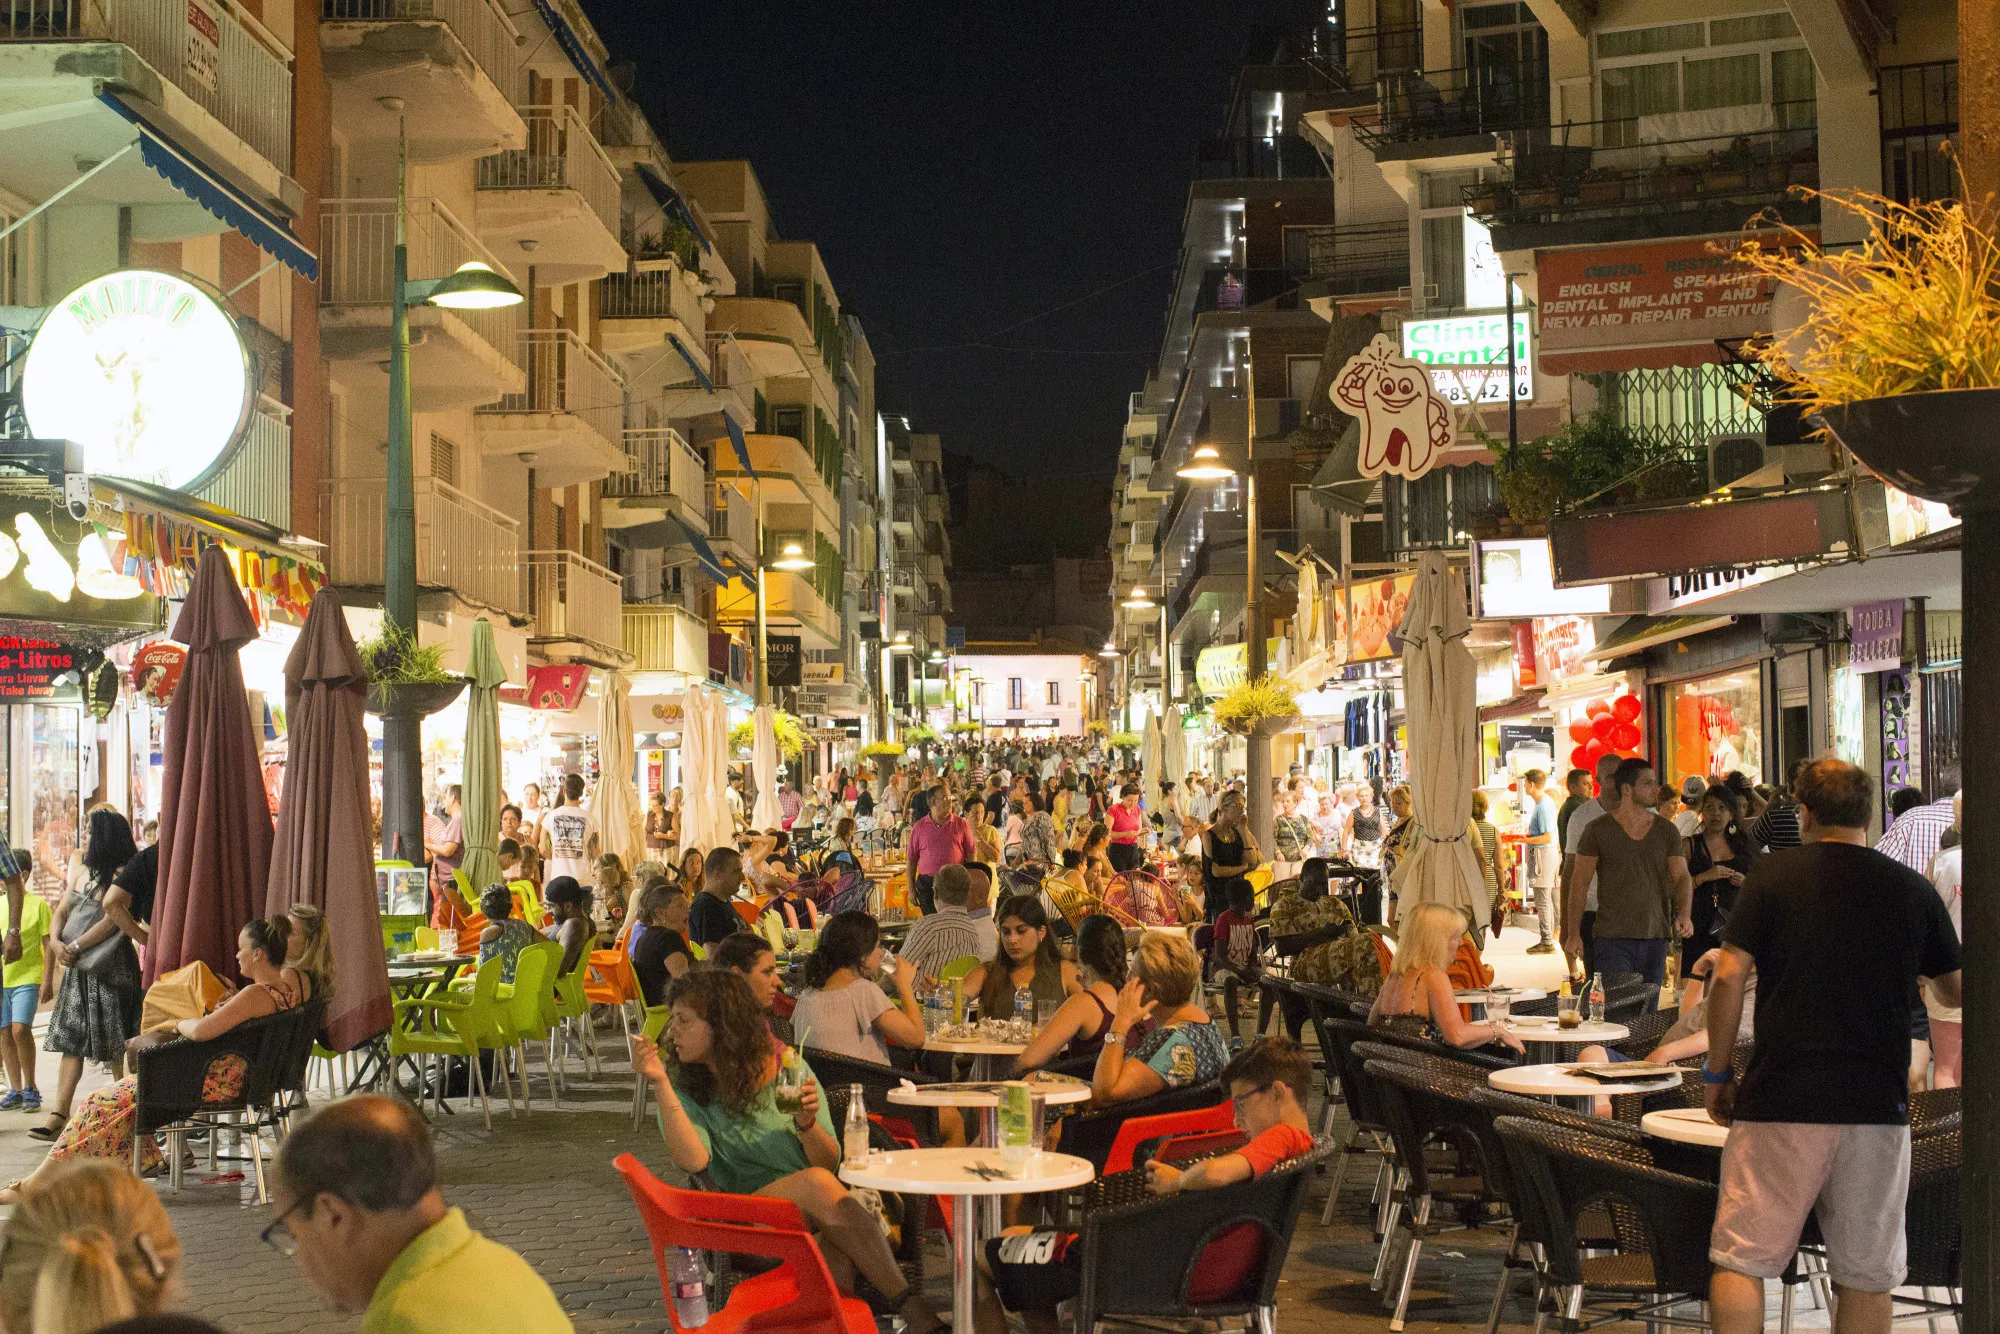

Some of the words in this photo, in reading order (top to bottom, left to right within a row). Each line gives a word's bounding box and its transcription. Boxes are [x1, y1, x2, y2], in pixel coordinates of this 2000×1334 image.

[1542, 298, 1608, 314] DENTAL
[1618, 290, 1704, 309] IMPLANTS
[1719, 287, 1757, 302] AND
[1558, 281, 1632, 298] ENGLISH
[1542, 313, 1585, 329] NEW
[1589, 312, 1623, 328] AND
[1630, 307, 1692, 324] REPAIR
[1858, 608, 1892, 632] TOUBA
[1850, 638, 1898, 663] BELLEZA
[28, 685, 56, 697] Away
[806, 693, 827, 704] EXCHANGE
